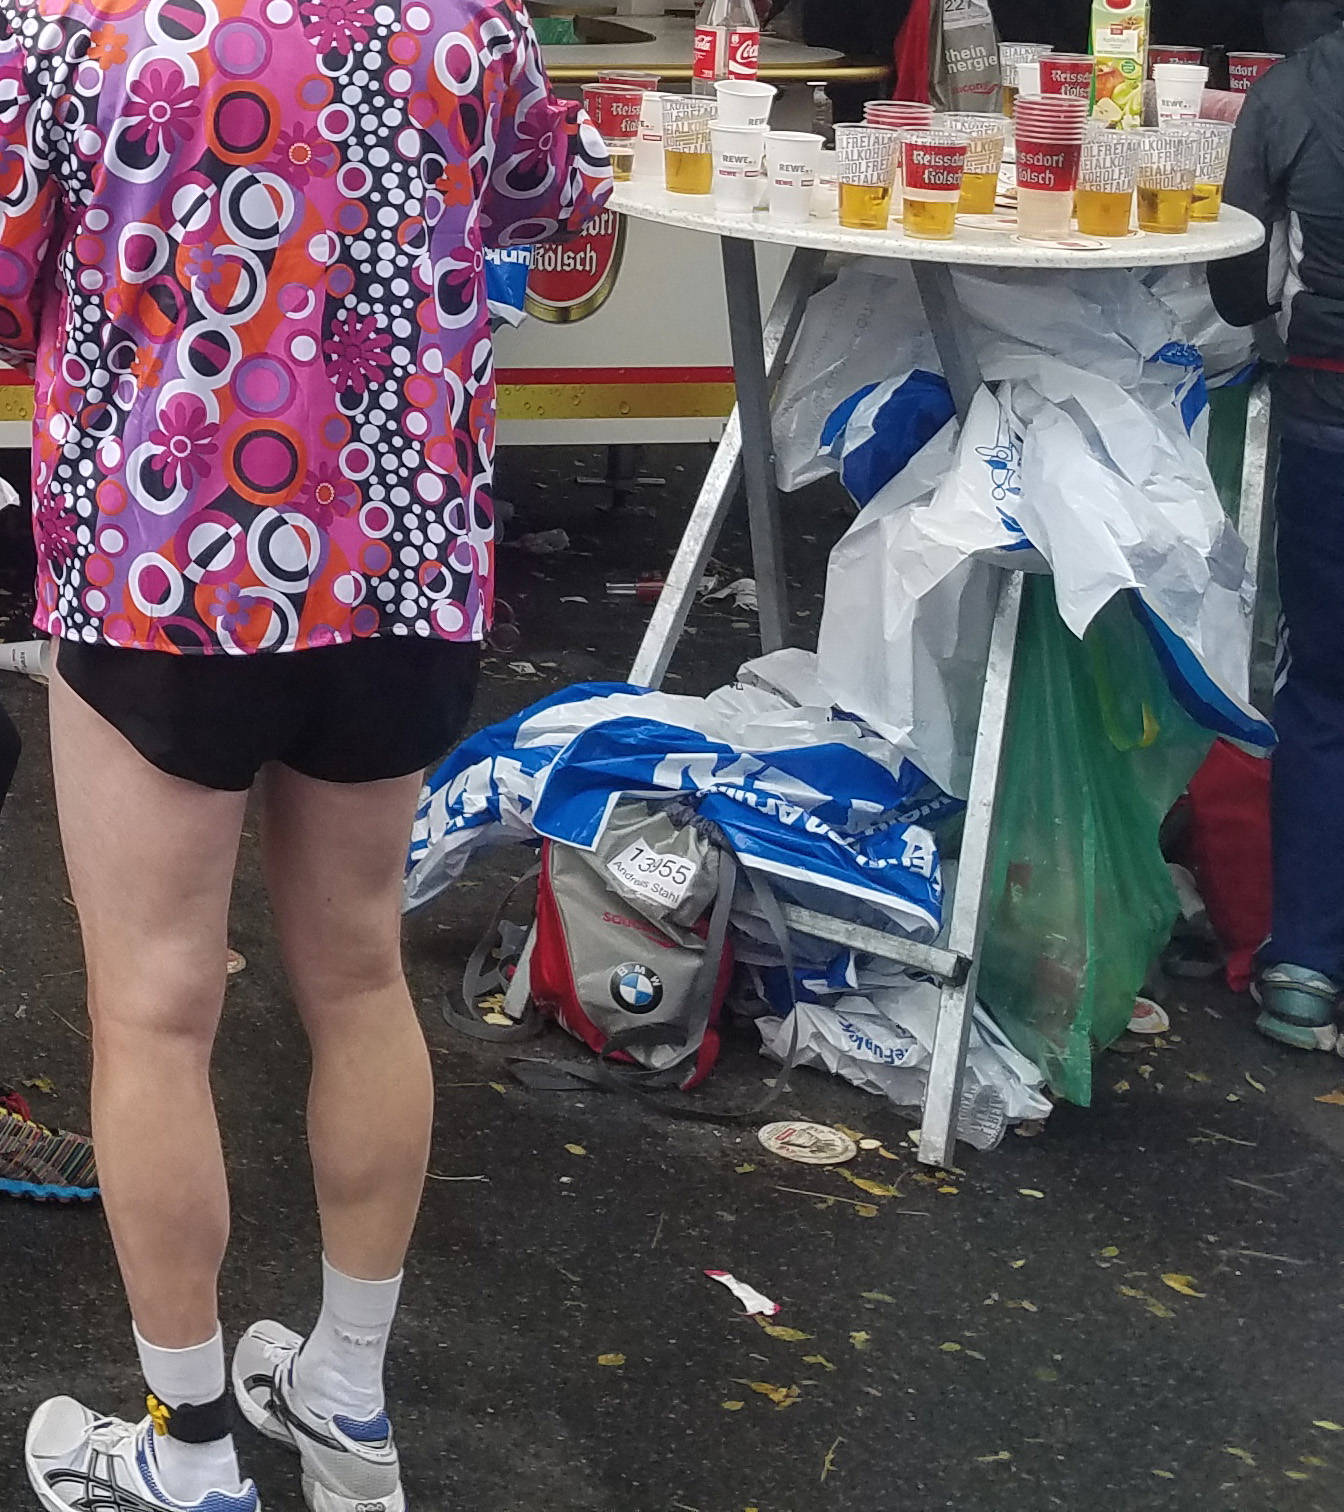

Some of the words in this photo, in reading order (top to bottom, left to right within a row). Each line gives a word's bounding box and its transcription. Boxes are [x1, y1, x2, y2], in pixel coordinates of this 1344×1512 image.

[722, 154, 750, 164] REWE
[778, 163, 805, 173] REWE
[529, 243, 597, 276] Kölsch
[650, 883, 680, 904] Stahl
[616, 963, 663, 987] BMW
